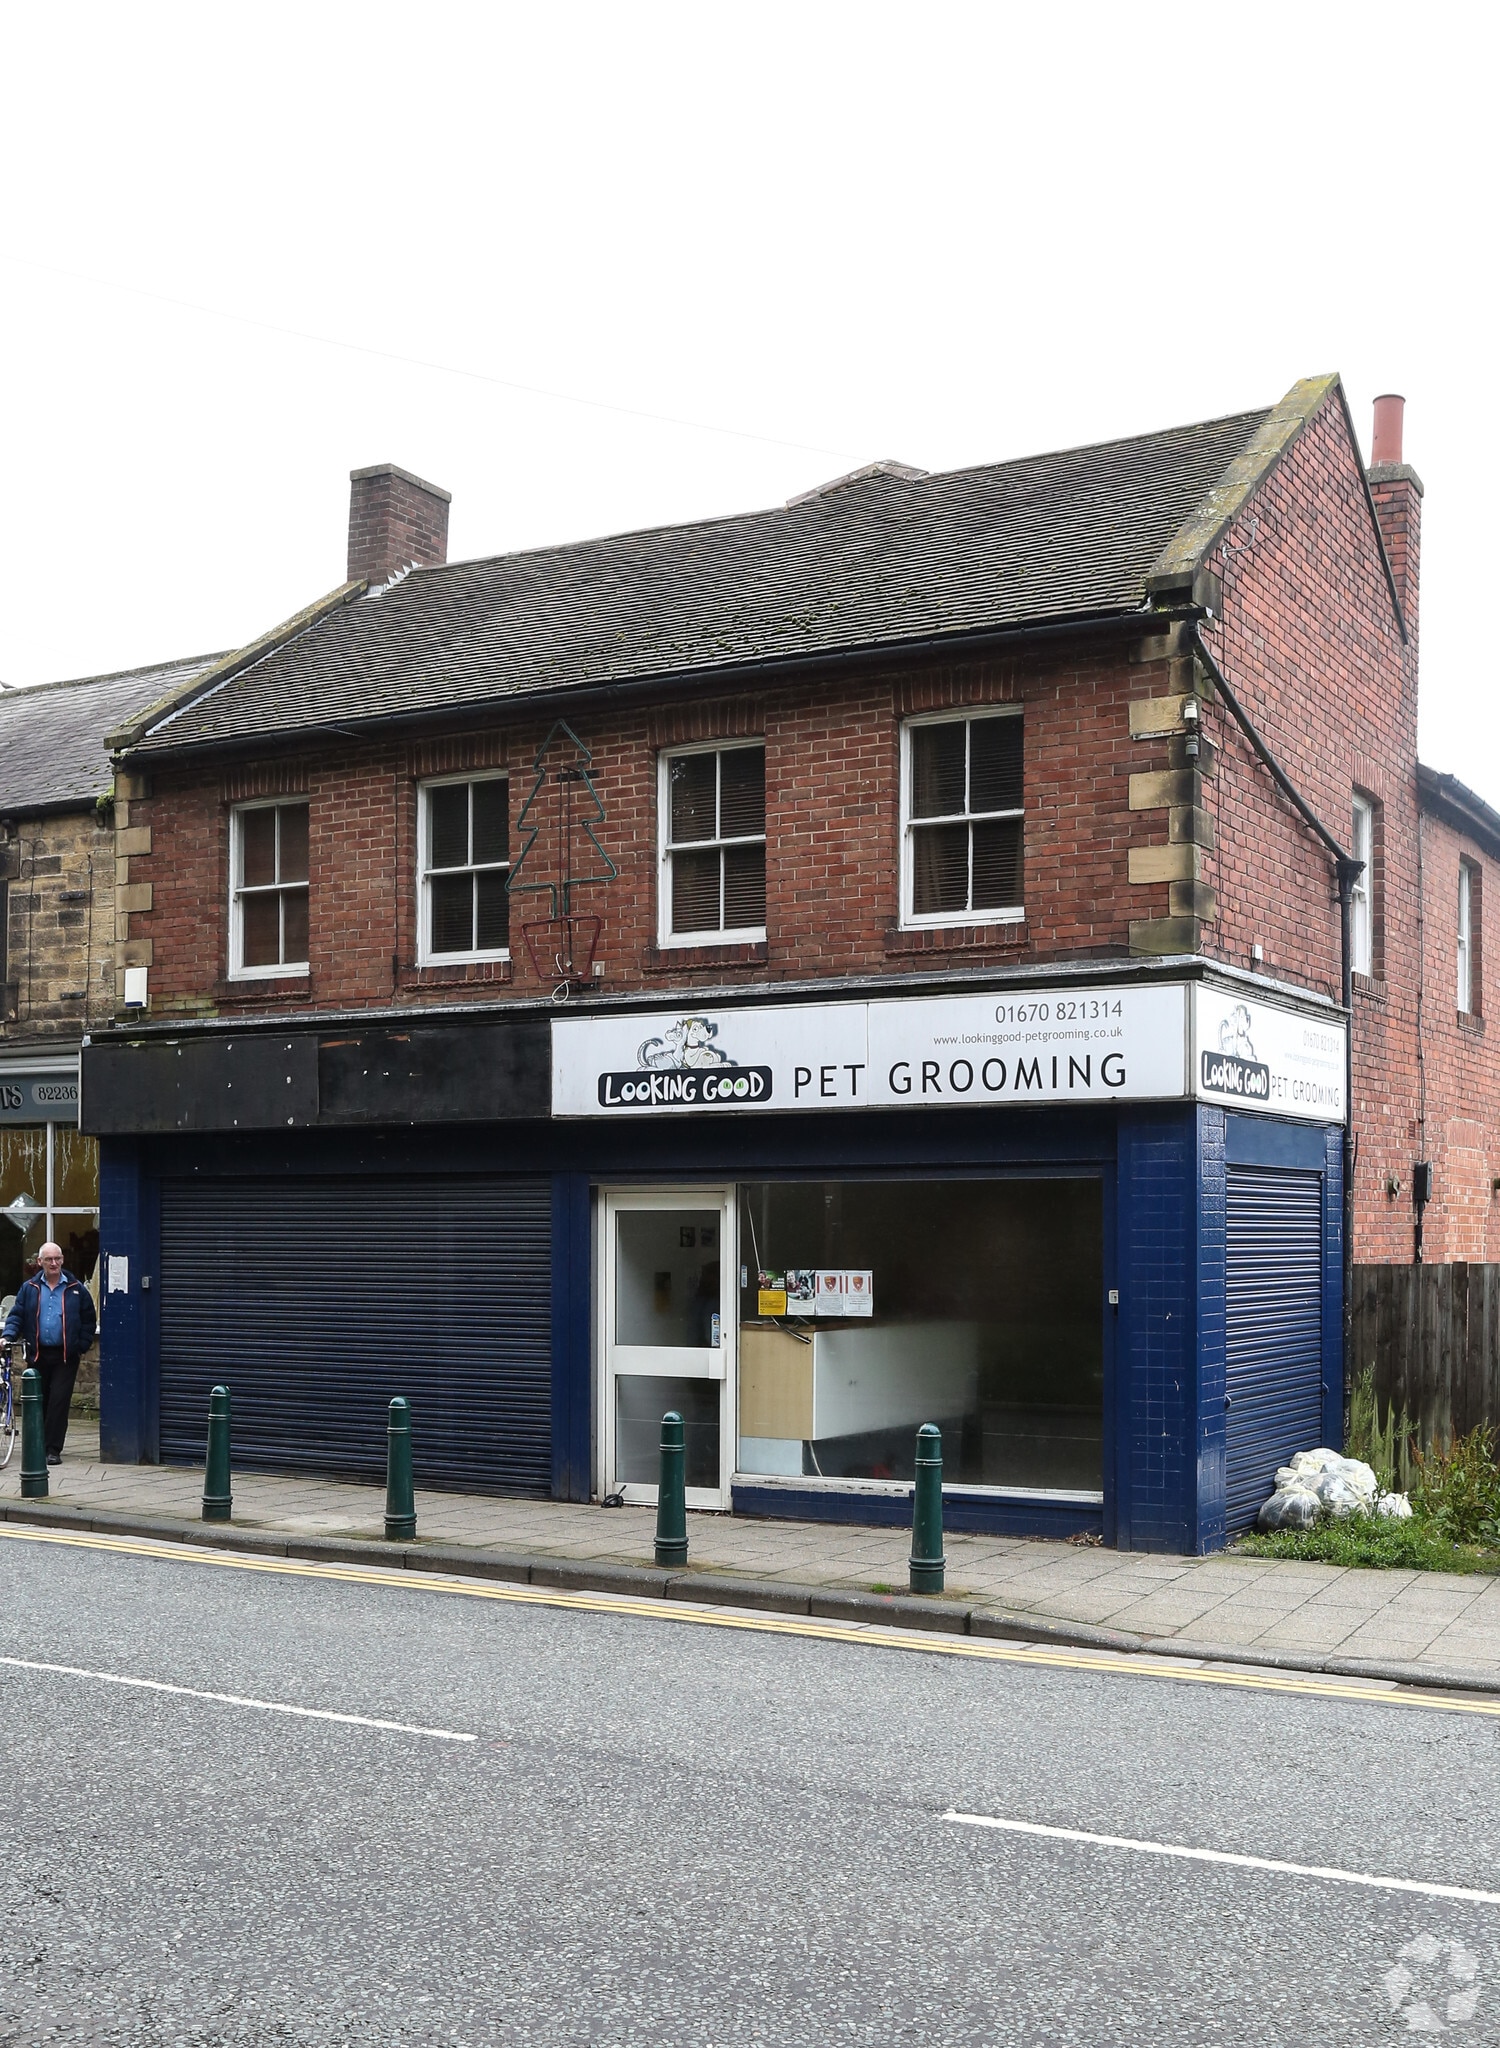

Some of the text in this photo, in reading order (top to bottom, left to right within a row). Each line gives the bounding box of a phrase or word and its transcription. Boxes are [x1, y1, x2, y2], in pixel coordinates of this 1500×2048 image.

[995, 1000, 1123, 1024] 01670 821314
[933, 1026, 1123, 1045] www.lookinggood-petgrooming.co.uk
[794, 1053, 1126, 1098] PET GROOMING
[1271, 1075, 1340, 1108] PET GROOMING
